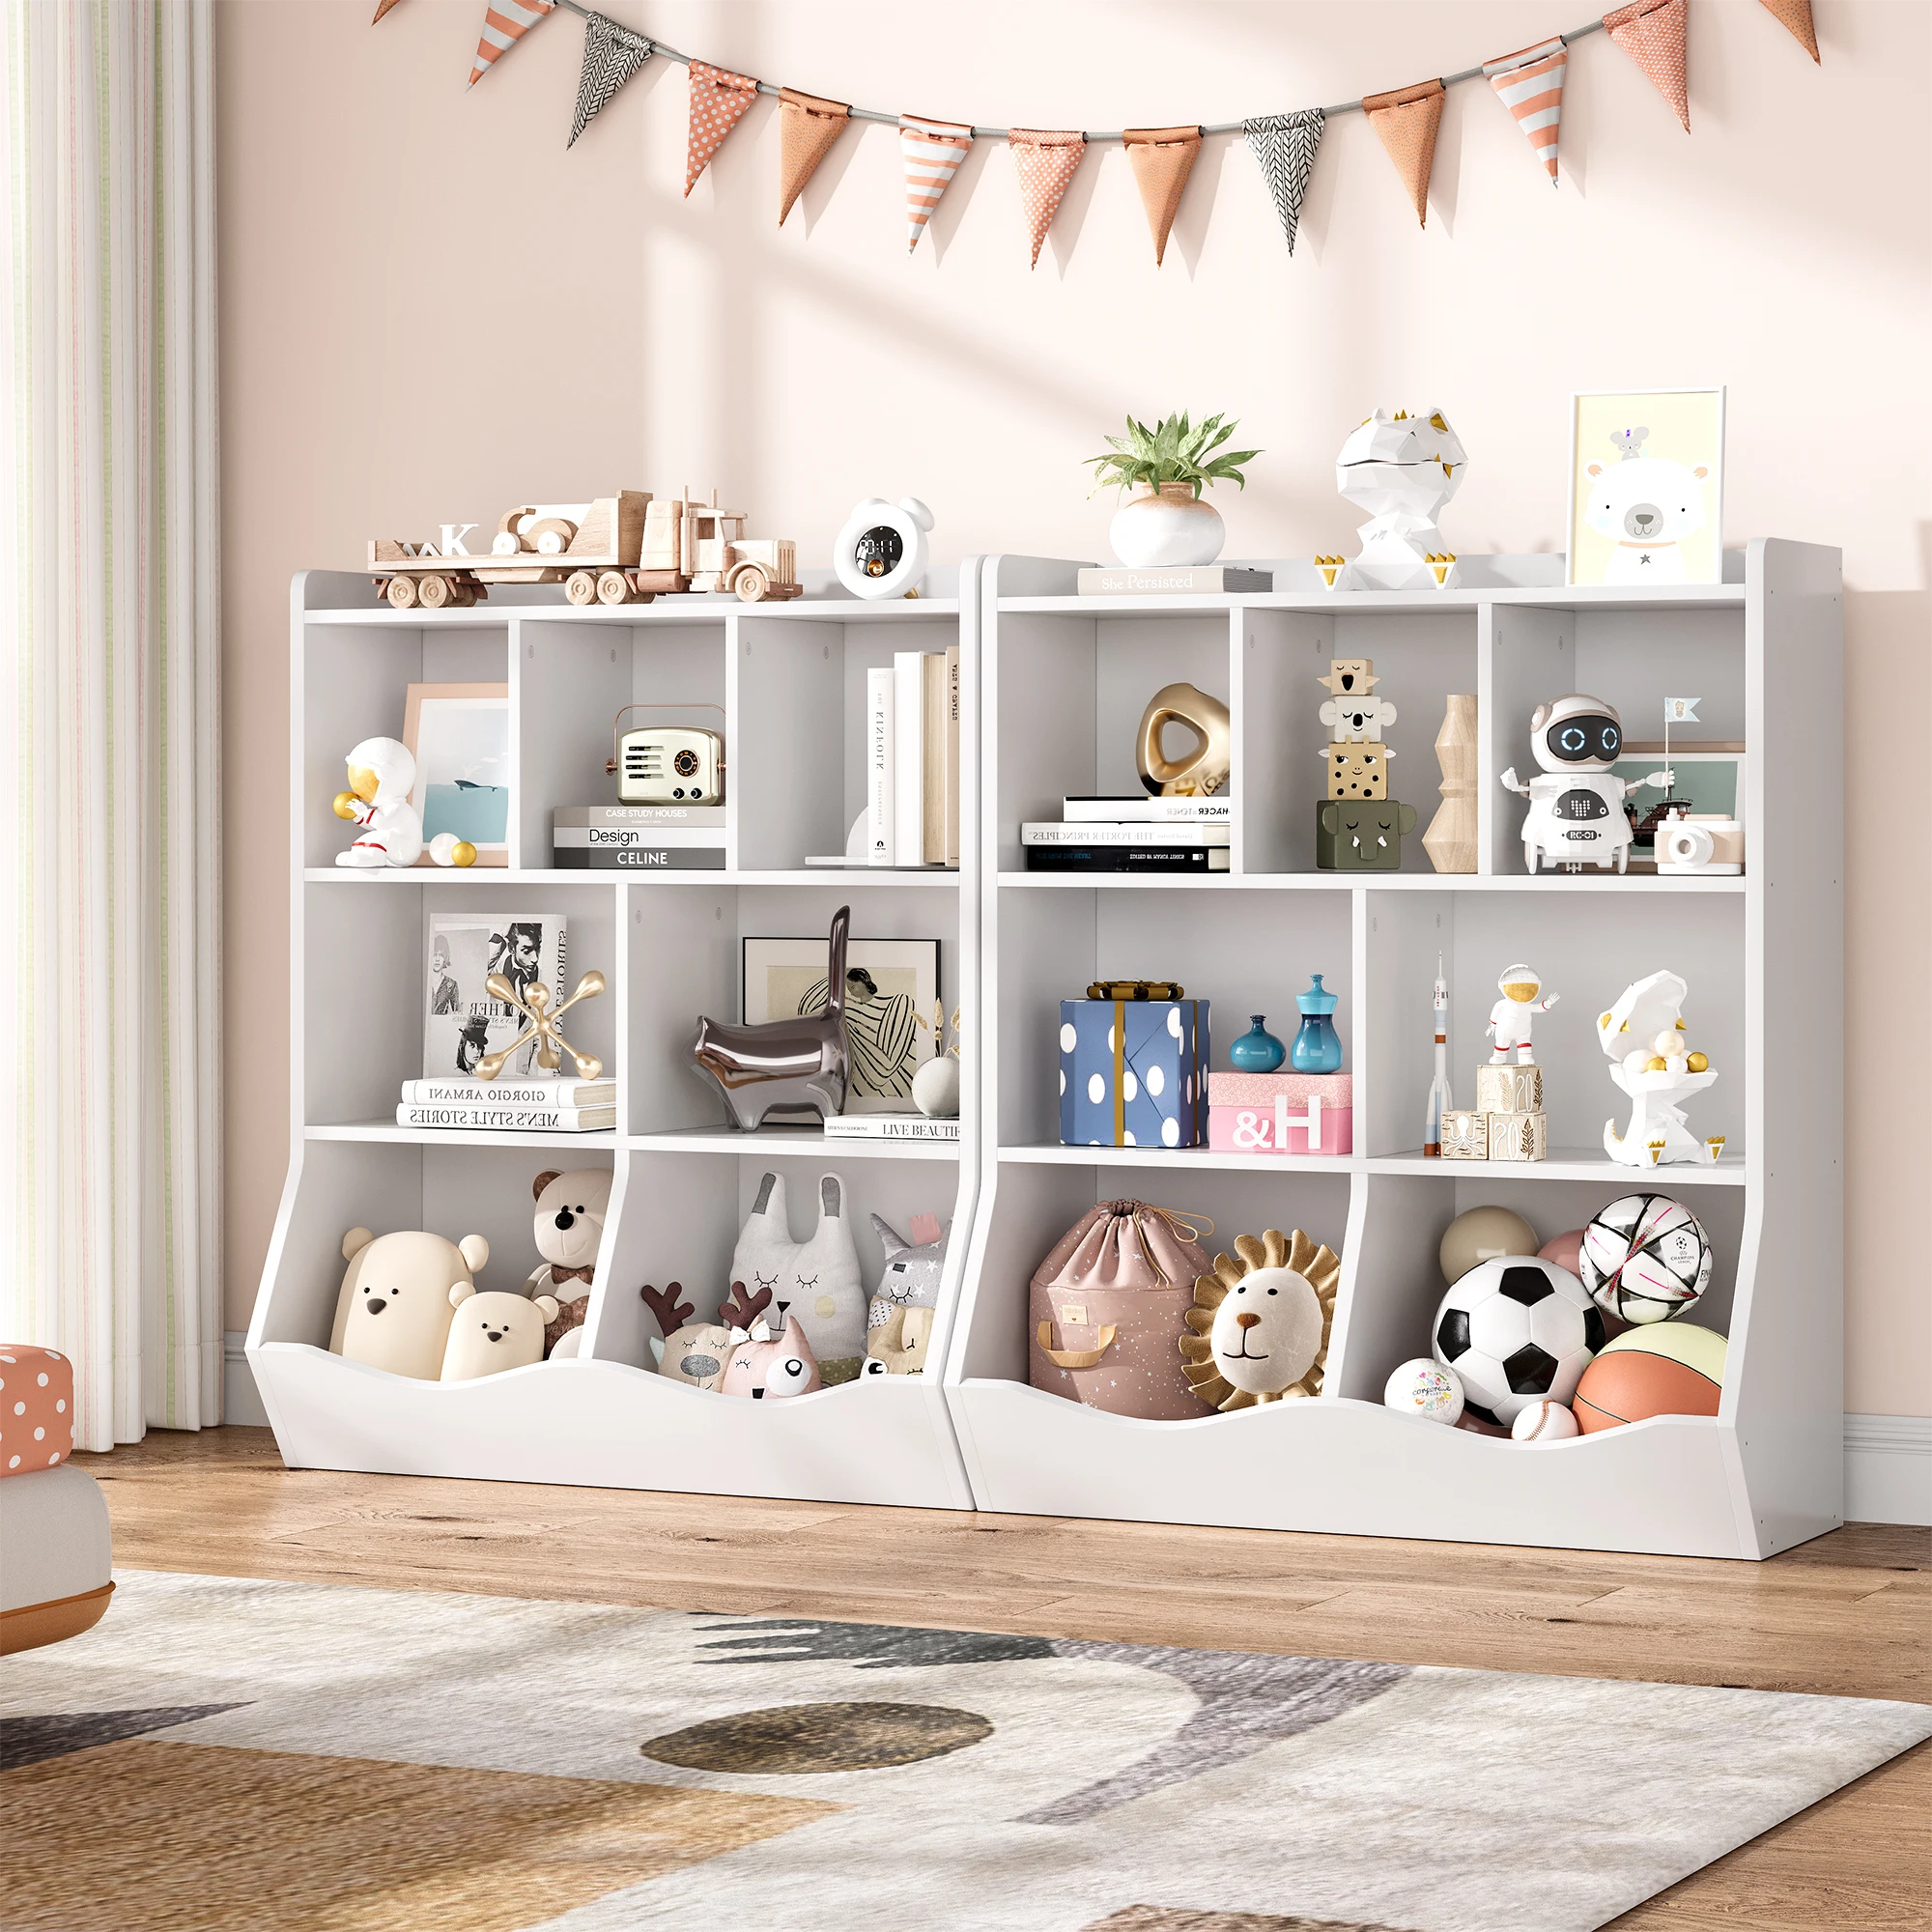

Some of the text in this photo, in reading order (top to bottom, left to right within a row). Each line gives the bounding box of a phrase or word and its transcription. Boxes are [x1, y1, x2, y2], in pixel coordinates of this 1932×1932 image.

[439, 524, 479, 555] K
[1101, 573, 1193, 590] She Persisted
[589, 829, 639, 847] Design
[1570, 831, 1595, 839] RC-01
[617, 852, 668, 865] CELINE
[1516, 1073, 1533, 1113] 20
[883, 1123, 910, 1136] LIVE
[1493, 1122, 1520, 1160] 20
